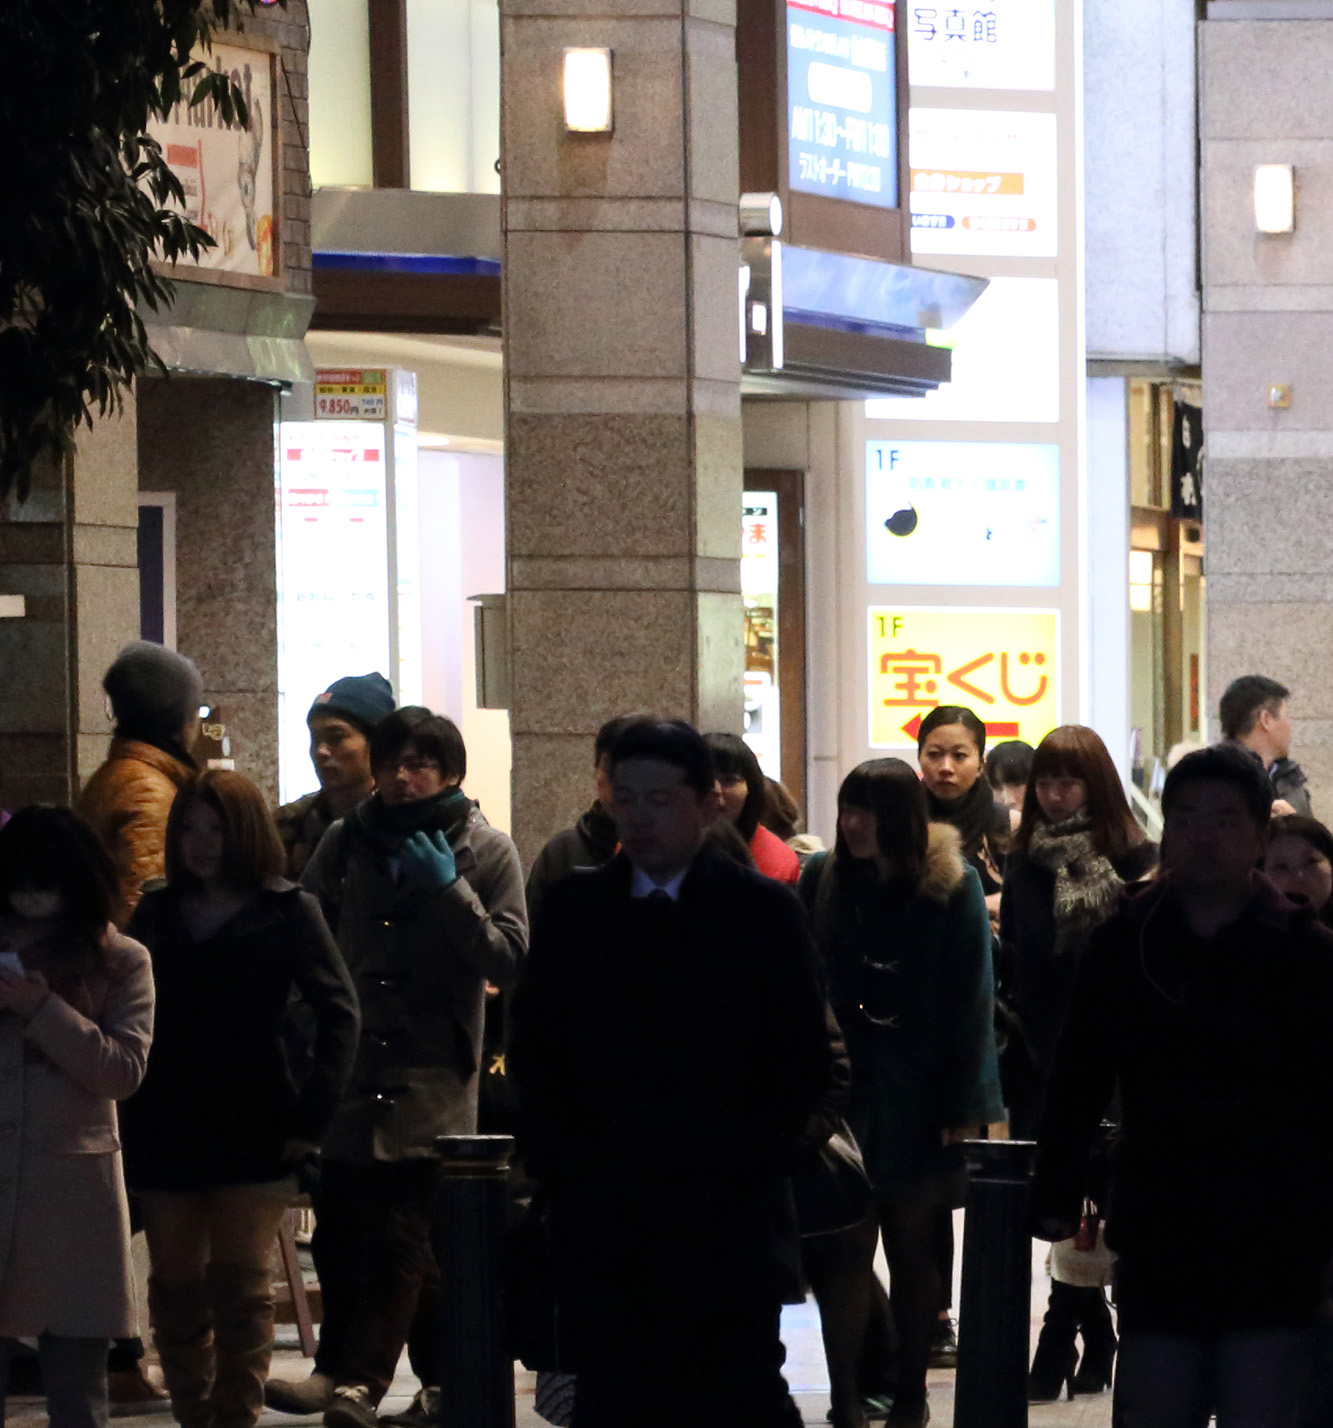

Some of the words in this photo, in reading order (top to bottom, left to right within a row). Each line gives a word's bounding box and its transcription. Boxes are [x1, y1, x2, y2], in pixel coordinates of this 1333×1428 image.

[913, 8, 998, 43] 写真館
[875, 449, 900, 470] 1F
[877, 617, 903, 638] 1F
[880, 649, 1047, 706] 宝くじ
